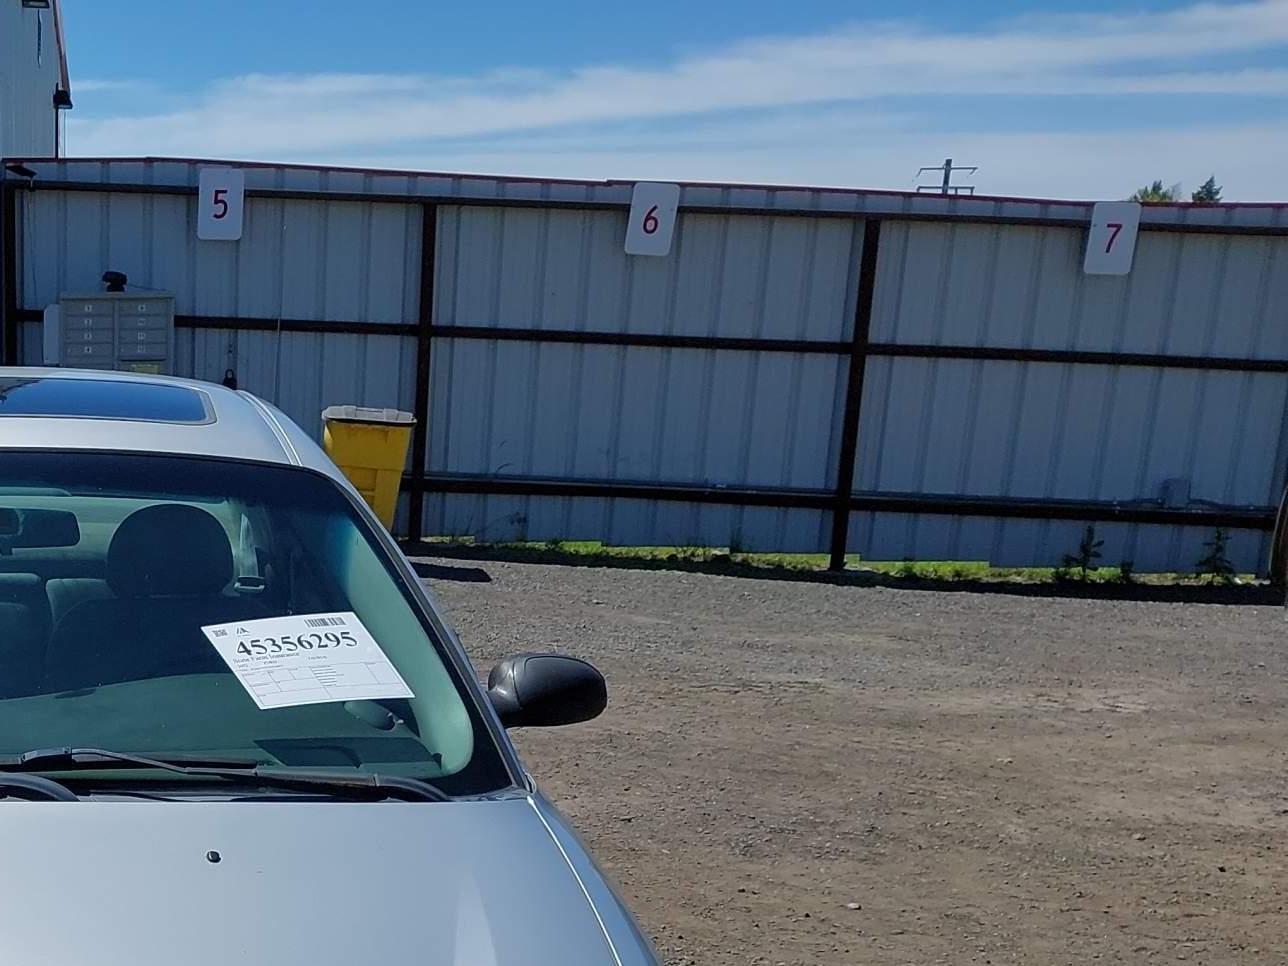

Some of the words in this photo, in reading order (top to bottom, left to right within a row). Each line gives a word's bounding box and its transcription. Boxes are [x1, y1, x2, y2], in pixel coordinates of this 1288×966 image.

[213, 189, 228, 219] 5
[642, 204, 659, 235] 6
[1105, 223, 1123, 254] 7
[236, 631, 358, 656] 45356295
